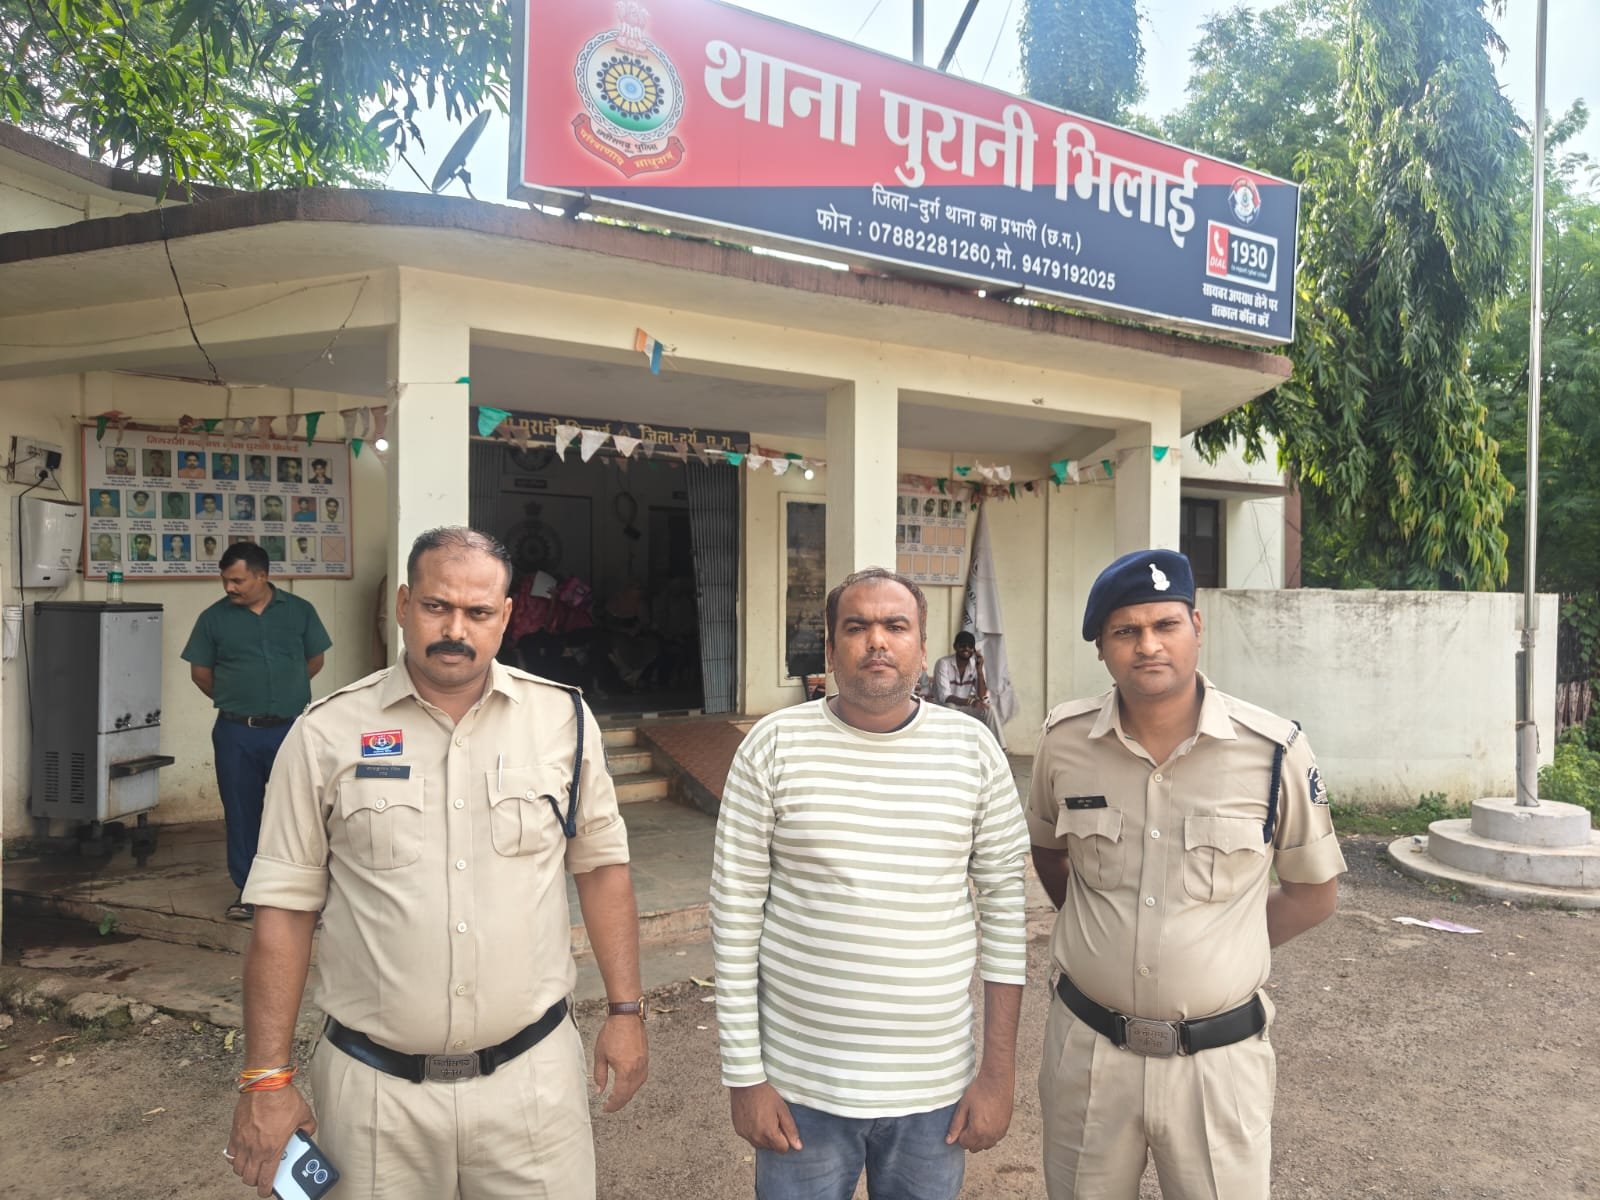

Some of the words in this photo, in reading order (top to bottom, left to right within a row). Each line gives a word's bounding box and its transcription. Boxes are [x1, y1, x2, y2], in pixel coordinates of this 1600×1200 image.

[704, 40, 861, 146] थाना
[880, 88, 1038, 193] पुरानी
[1052, 121, 1198, 249] भिलाई
[816, 203, 852, 236] फोन
[1022, 254, 1116, 291] 9479192025
[945, 204, 976, 228] थाना
[980, 212, 998, 233] का
[1001, 218, 1037, 242] प्रभारी
[1041, 223, 1082, 256] (छ.ग.)
[1209, 255, 1227, 270] DIAL
[1231, 239, 1268, 270] 1930
[1202, 282, 1228, 300] सायबर
[1228, 289, 1254, 307] अपराध
[1254, 292, 1268, 310] होने
[1268, 297, 1279, 312] पर
